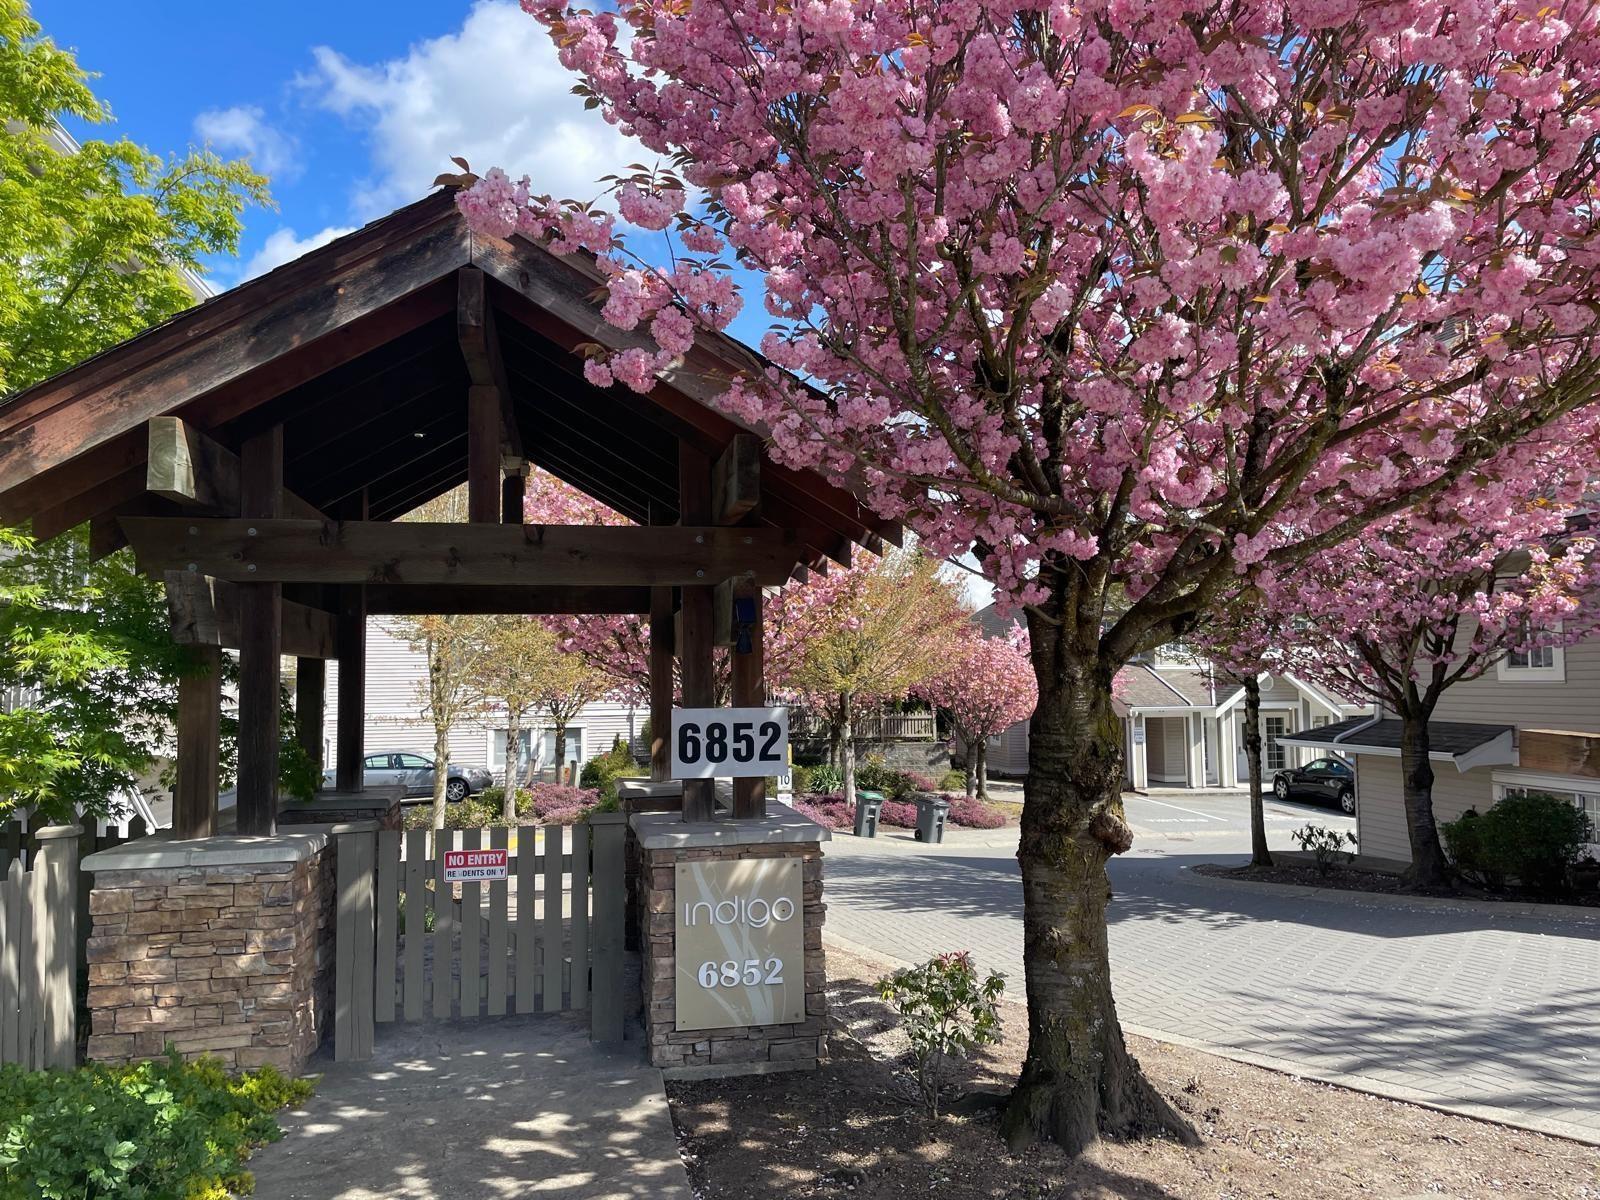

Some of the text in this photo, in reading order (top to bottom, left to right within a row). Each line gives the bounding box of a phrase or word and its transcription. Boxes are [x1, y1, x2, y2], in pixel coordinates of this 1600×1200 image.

[678, 721, 782, 764] 6852
[447, 868, 505, 878] REDENTS ONY
[448, 853, 504, 866] NO ENTRY
[685, 895, 795, 928] indigo
[698, 957, 784, 989] 6852
